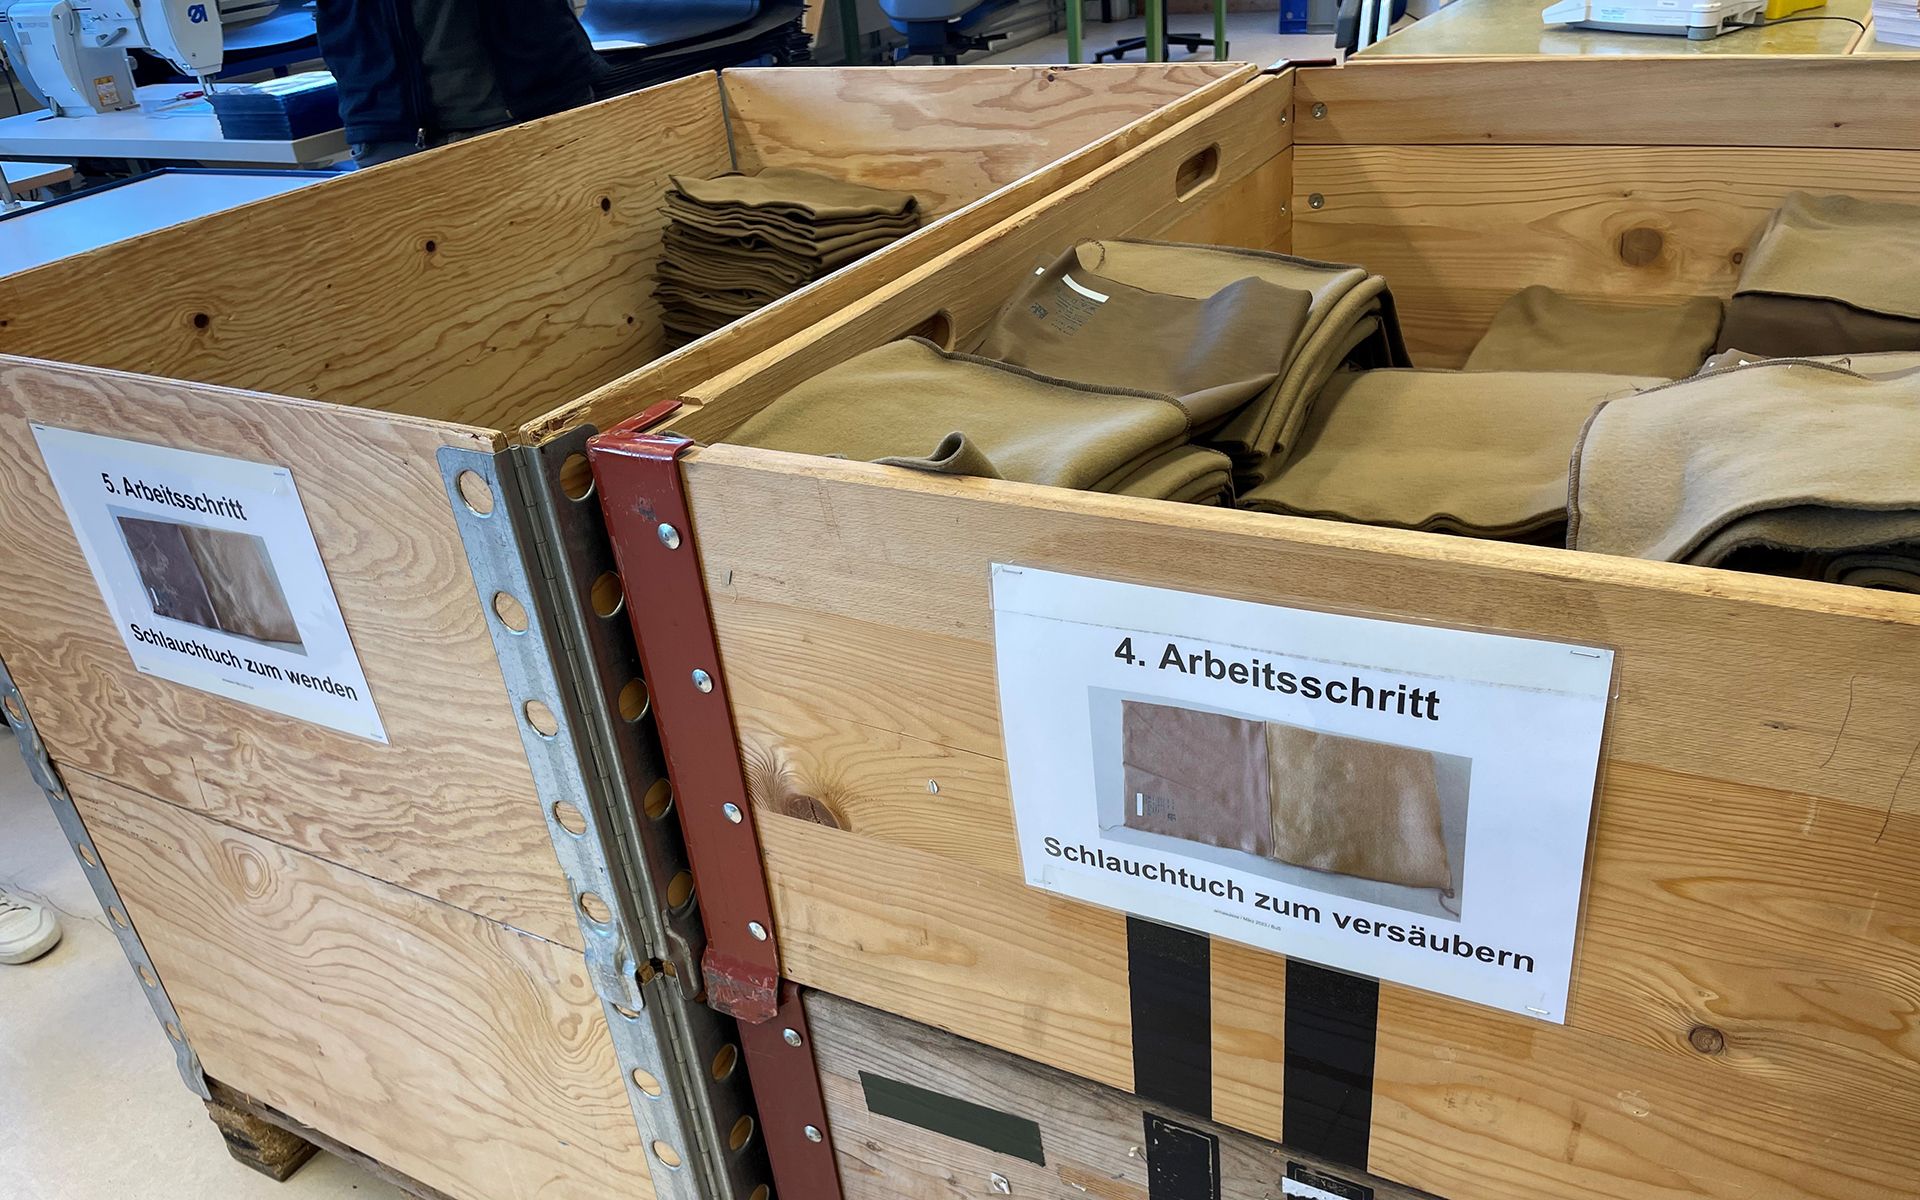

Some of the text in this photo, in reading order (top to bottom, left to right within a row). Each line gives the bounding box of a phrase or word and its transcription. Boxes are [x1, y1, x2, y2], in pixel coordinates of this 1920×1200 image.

[101, 472, 248, 521] 5. Arbeitsschritt
[130, 623, 243, 670] Schlauchtuch
[243, 658, 283, 682] zum
[284, 669, 359, 701] wenden
[1114, 637, 1440, 721] 4. Arbeitsschritt
[1044, 836, 1534, 974] Schlauchtuch zum versäubern
